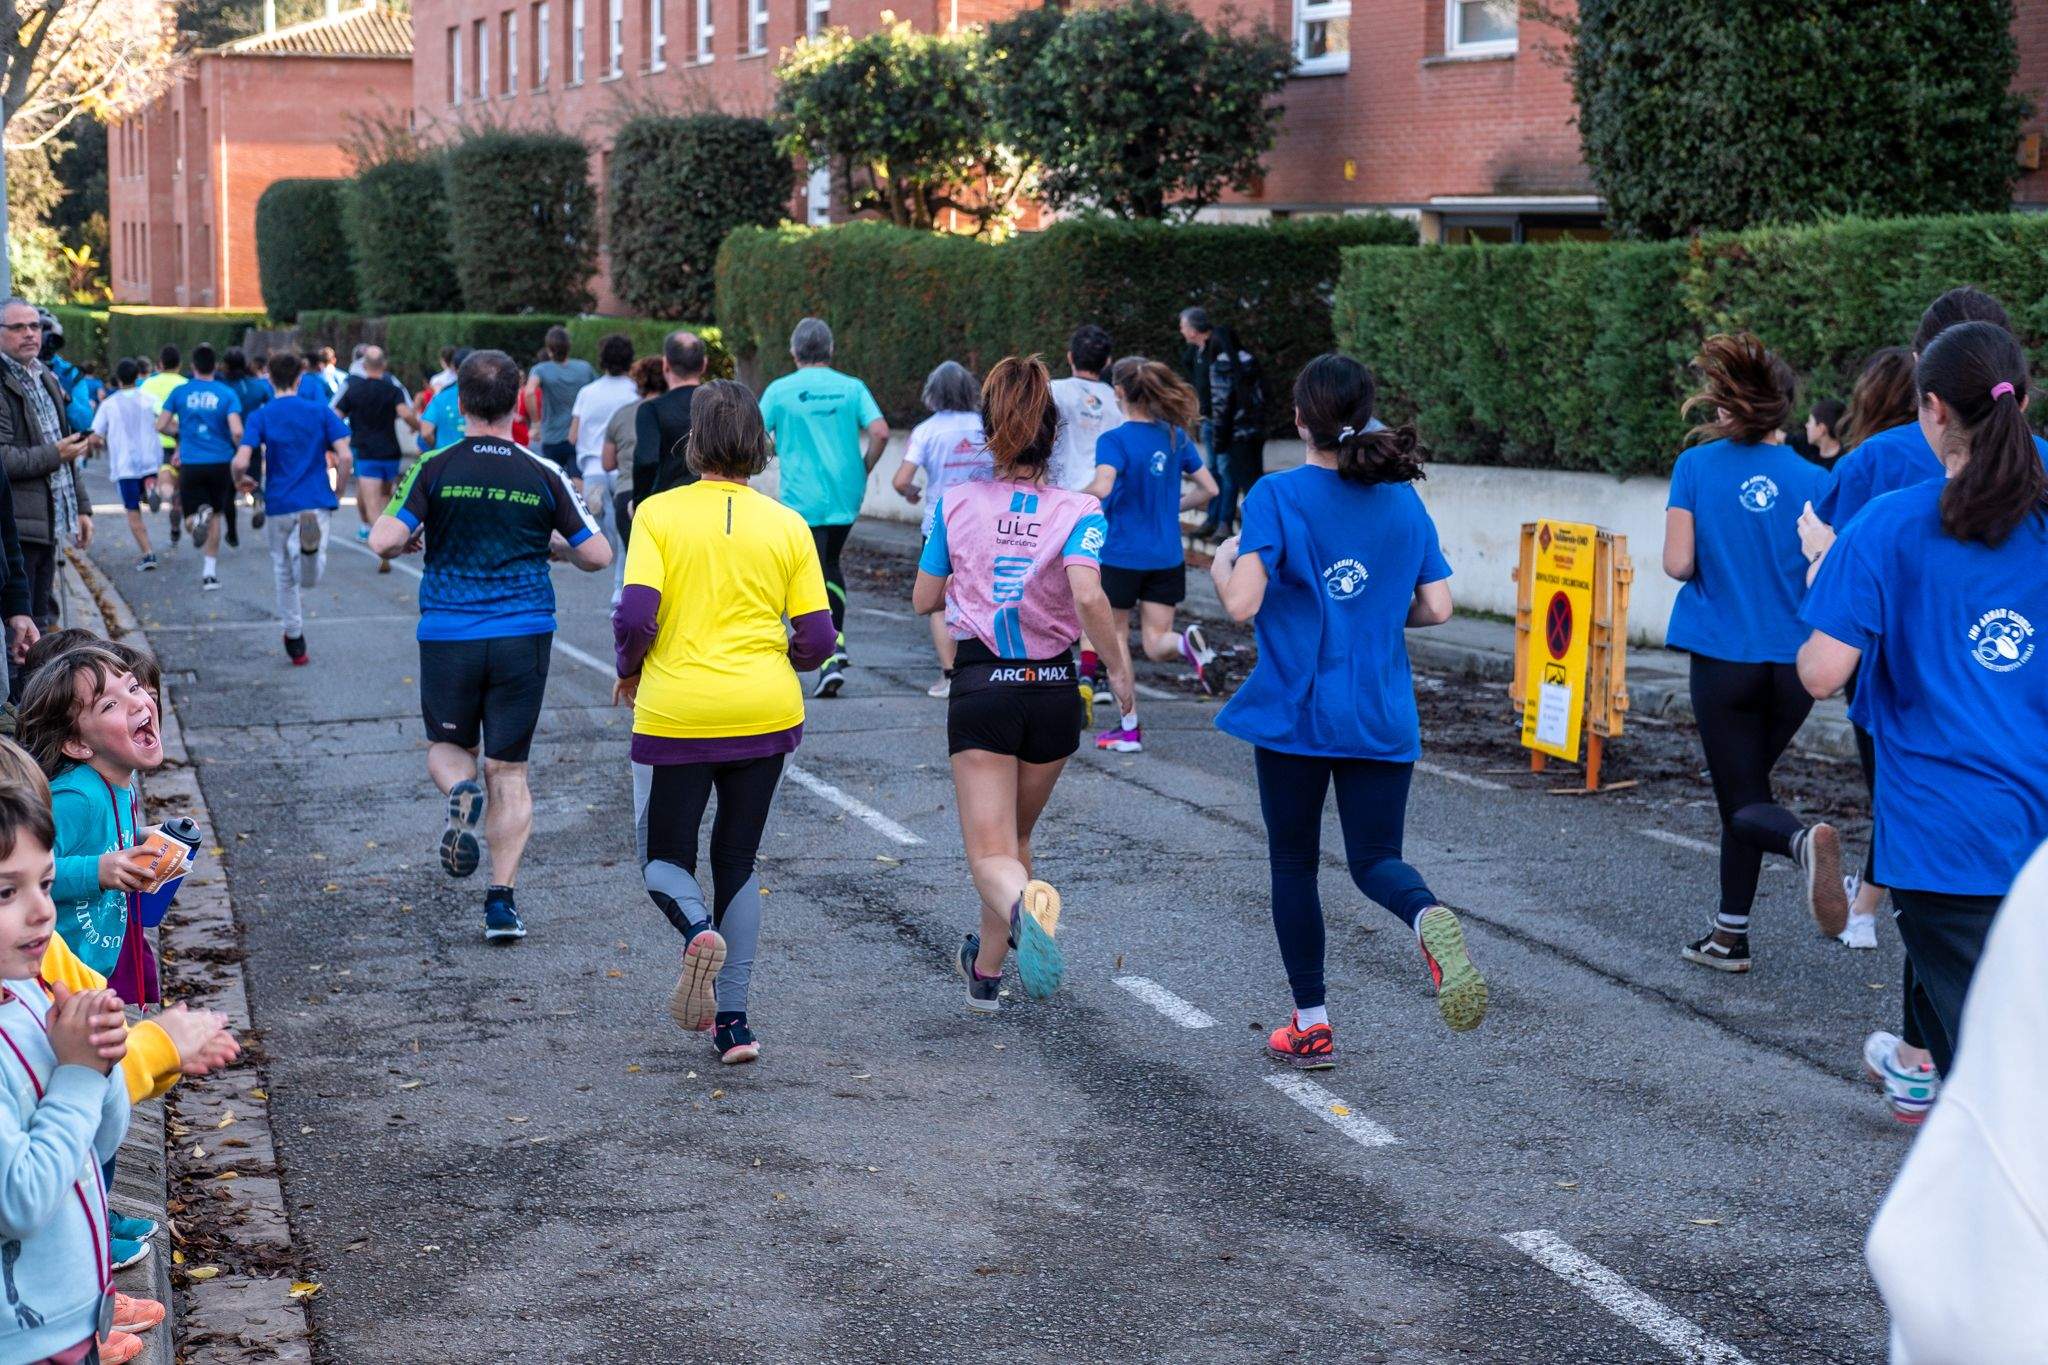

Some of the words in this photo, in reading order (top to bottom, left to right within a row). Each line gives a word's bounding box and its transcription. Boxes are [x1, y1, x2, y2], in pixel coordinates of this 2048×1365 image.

[472, 444, 512, 456] CARLOS
[441, 486, 483, 498] BORN
[487, 488, 506, 501] TO
[509, 491, 541, 506] RUN
[996, 537, 1037, 547] barcelona
